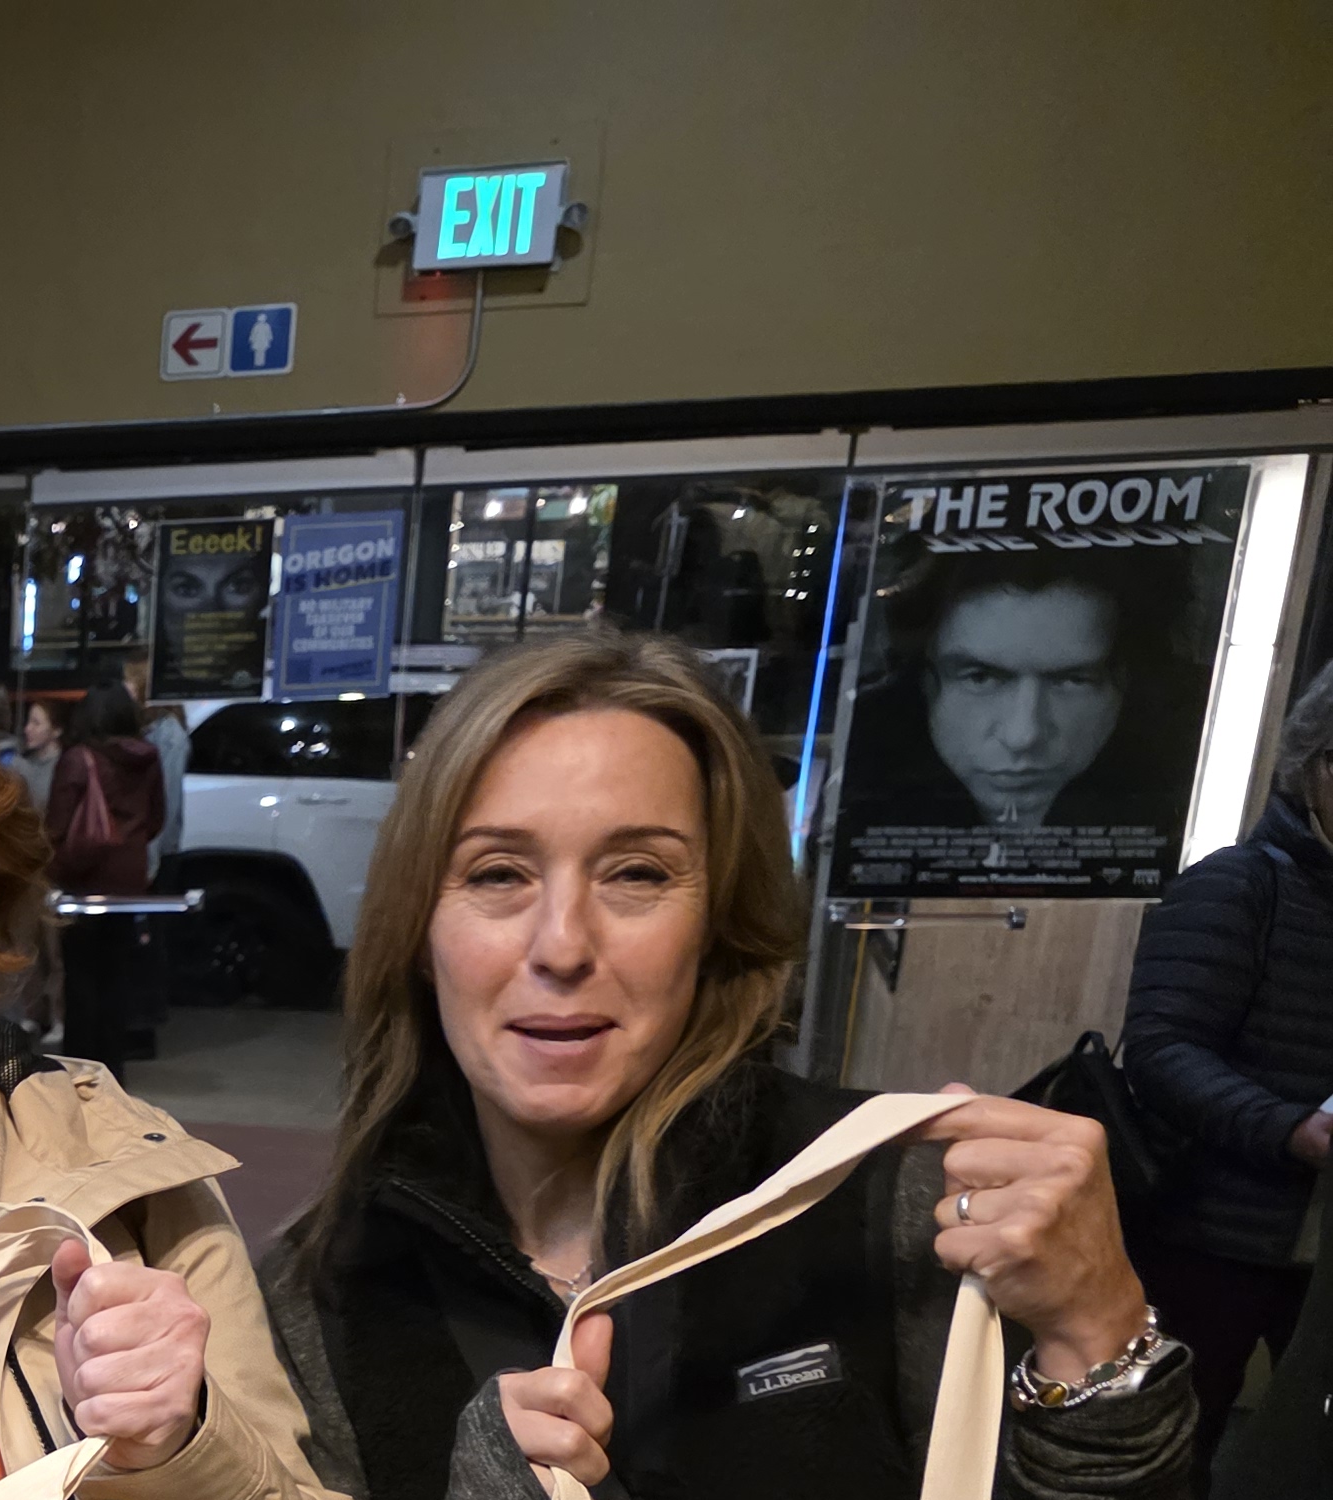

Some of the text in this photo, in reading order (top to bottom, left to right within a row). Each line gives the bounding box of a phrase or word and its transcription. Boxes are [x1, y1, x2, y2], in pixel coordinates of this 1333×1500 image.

[437, 171, 546, 259] EXIT
[903, 476, 1204, 535] THE ROOM
[284, 537, 395, 574] OREGON
[284, 559, 393, 593] IS HOME
